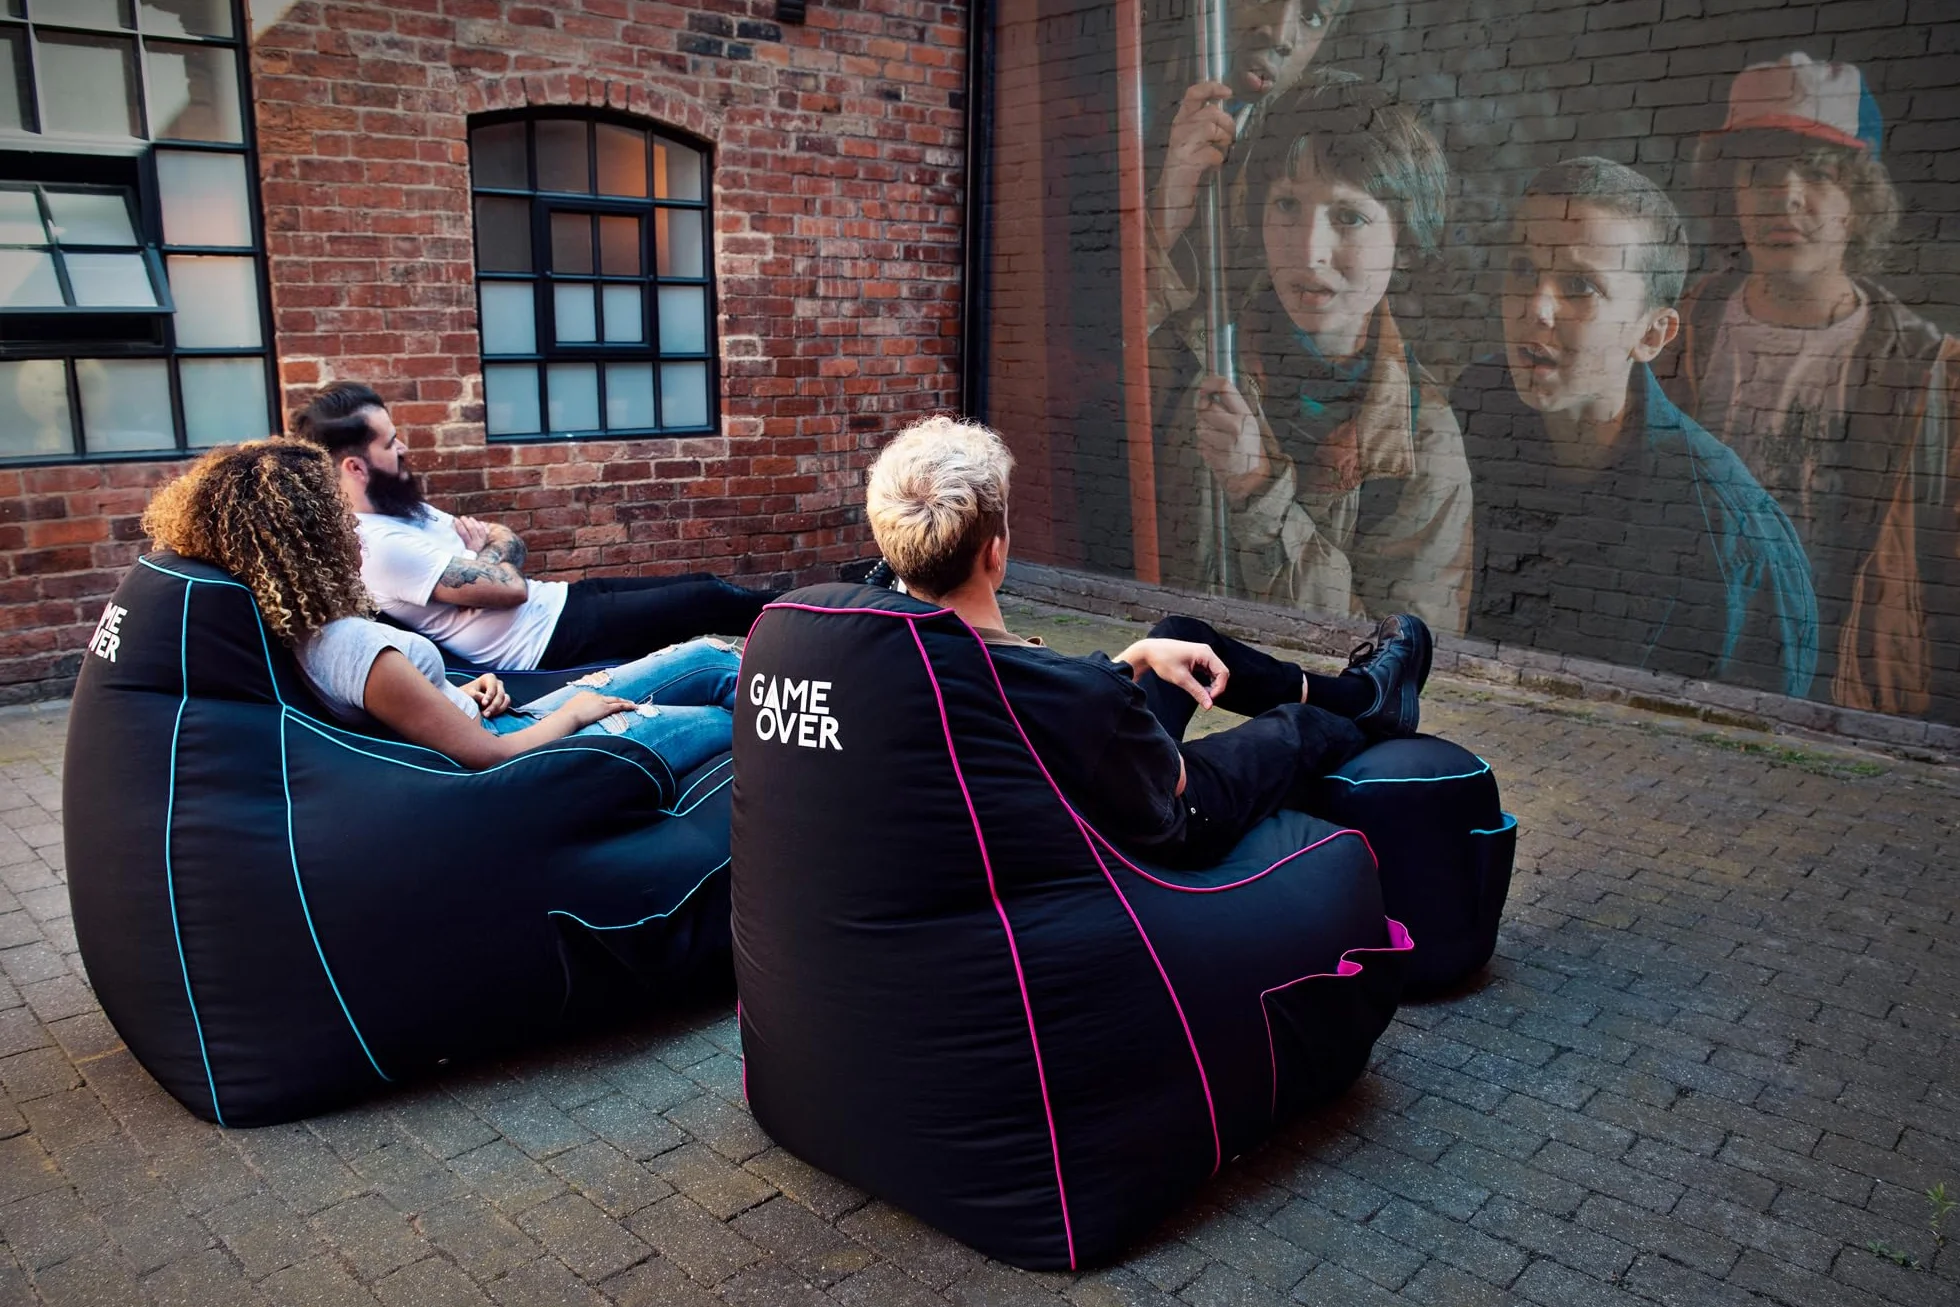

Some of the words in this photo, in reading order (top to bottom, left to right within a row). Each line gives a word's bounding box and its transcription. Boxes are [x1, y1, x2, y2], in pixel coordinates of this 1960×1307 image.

[100, 602, 128, 634] ME
[88, 627, 121, 663] VER
[750, 673, 832, 715] GAME
[756, 708, 844, 751] OVER
